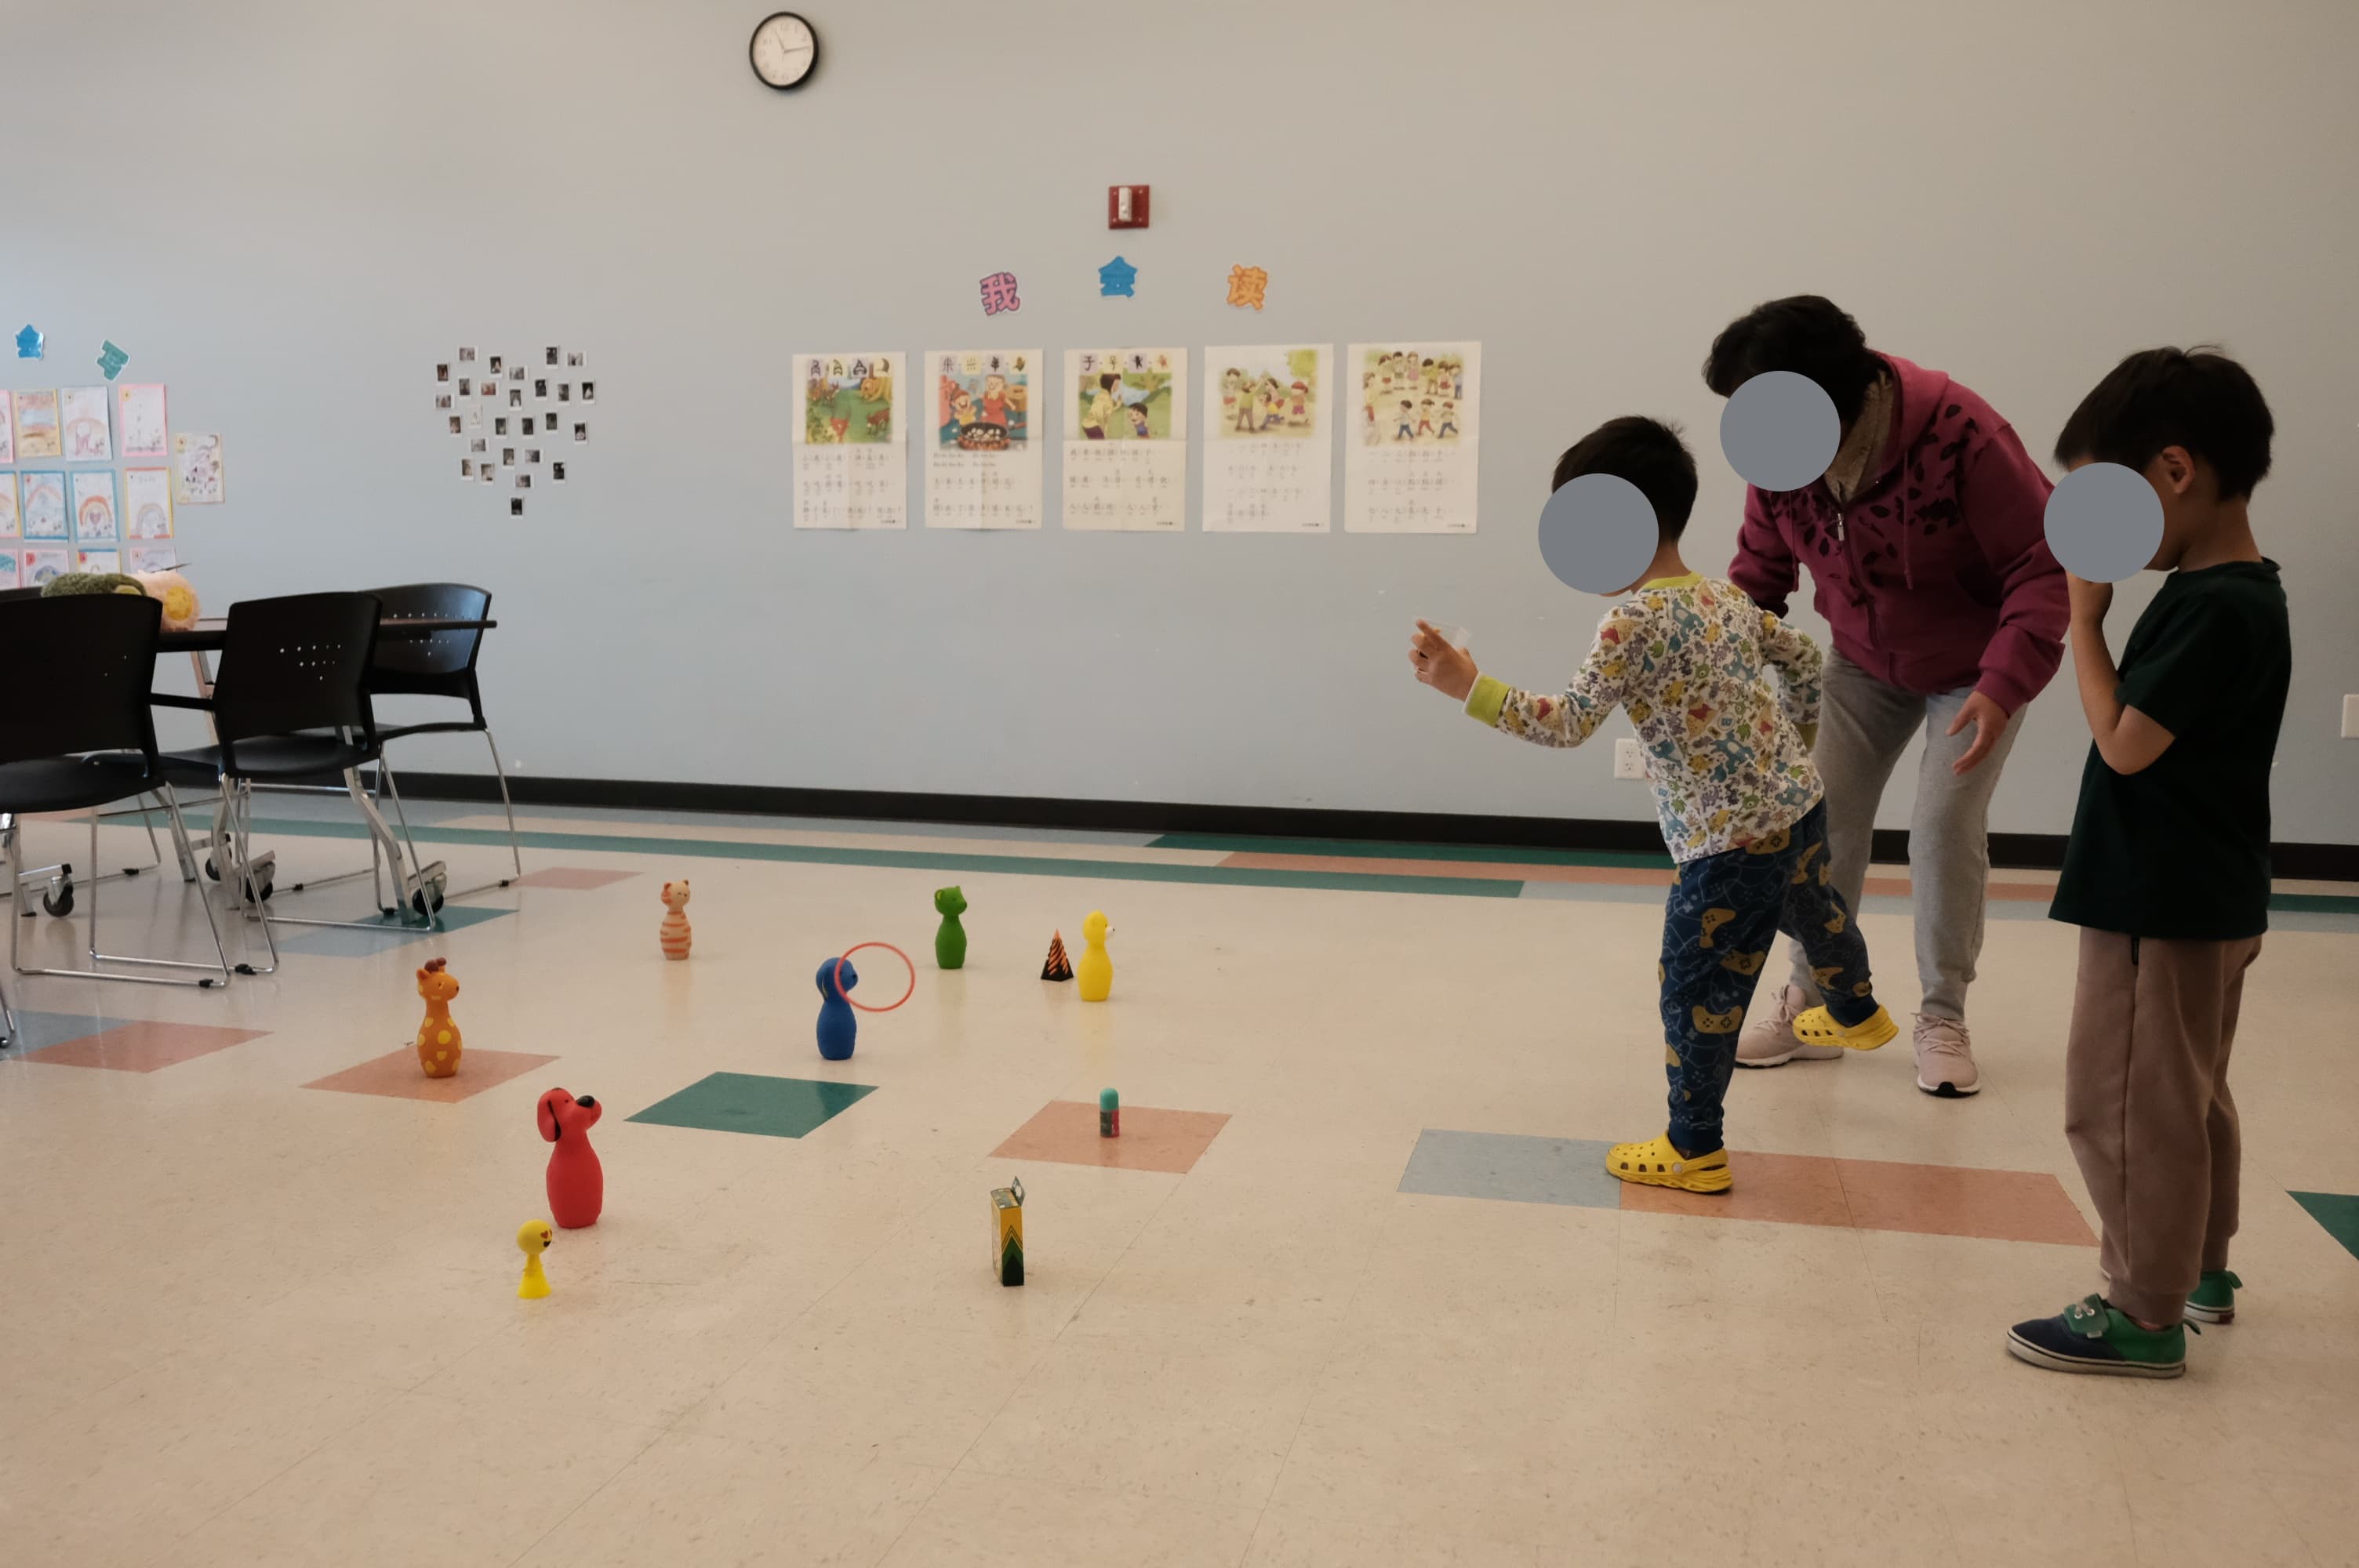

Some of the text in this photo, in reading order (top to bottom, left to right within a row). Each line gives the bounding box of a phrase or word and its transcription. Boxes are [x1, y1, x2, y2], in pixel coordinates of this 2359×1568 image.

[980, 255, 1268, 315] 我 会 读
